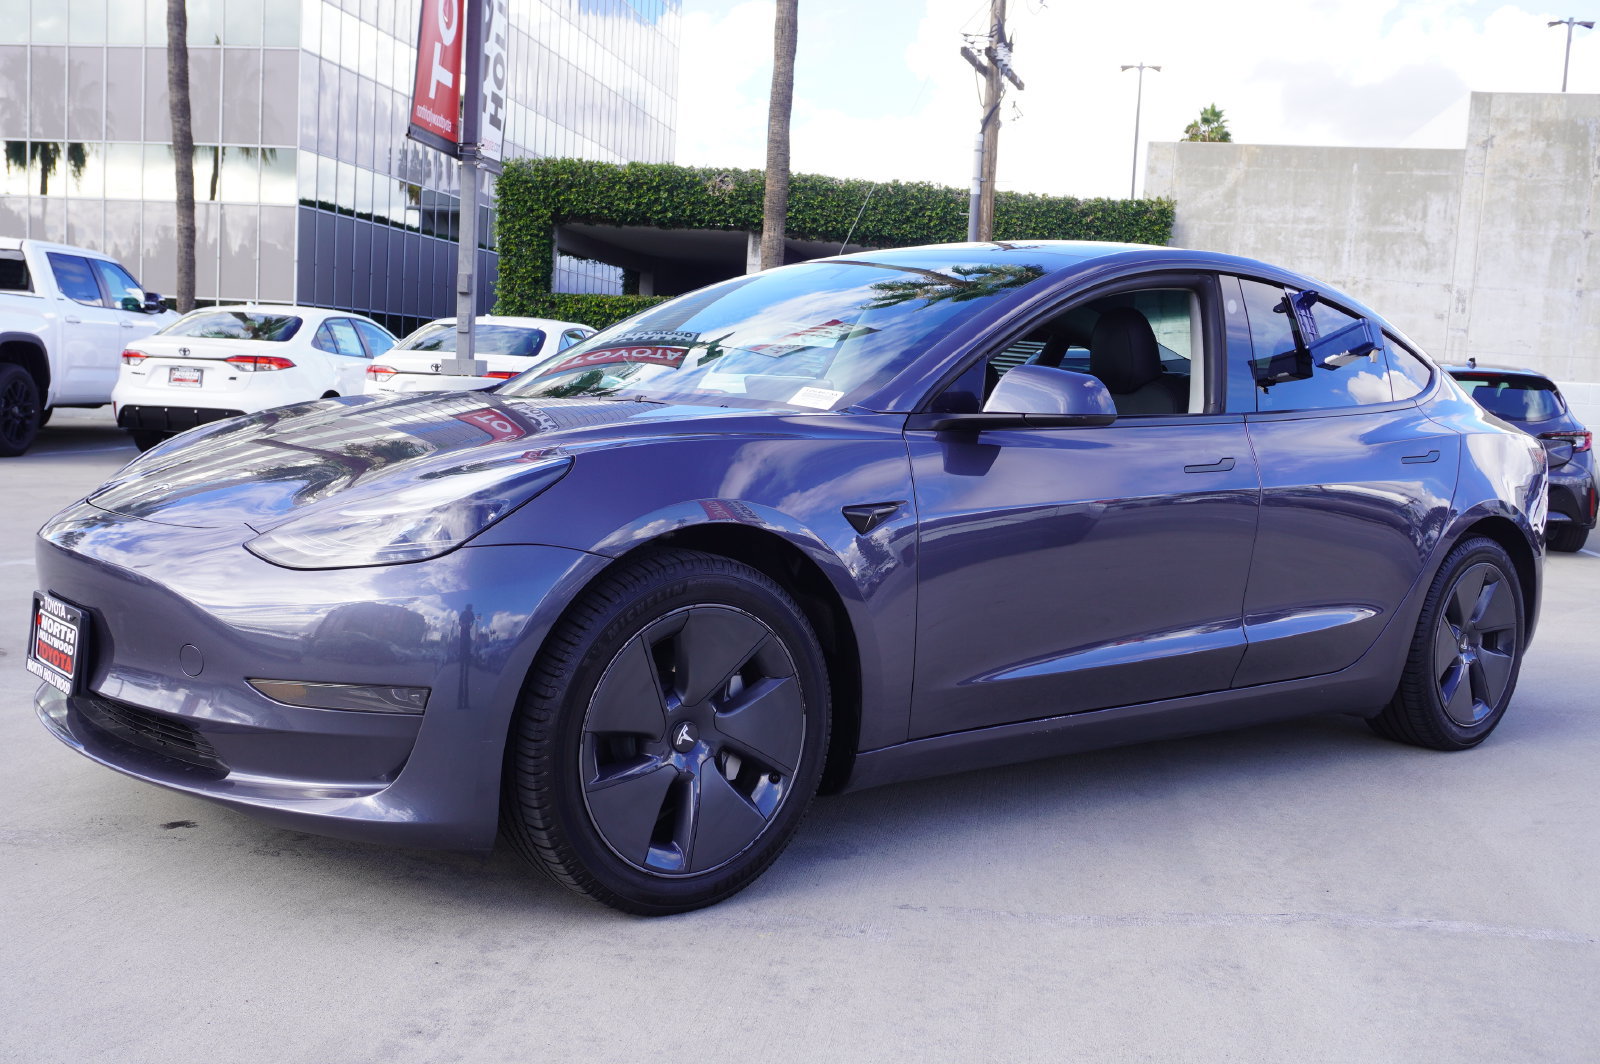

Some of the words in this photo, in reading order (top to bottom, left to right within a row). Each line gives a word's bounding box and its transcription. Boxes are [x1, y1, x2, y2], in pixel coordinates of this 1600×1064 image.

[44, 597, 66, 618] TOYOTA
[606, 582, 688, 640] MICHELIN
[39, 629, 73, 655] HOLLYWOOD
[41, 615, 75, 643] NORTH
[38, 640, 72, 673] TOYOTA
[27, 659, 43, 677] NORTH
[43, 668, 71, 695] HOLLYWOOD
